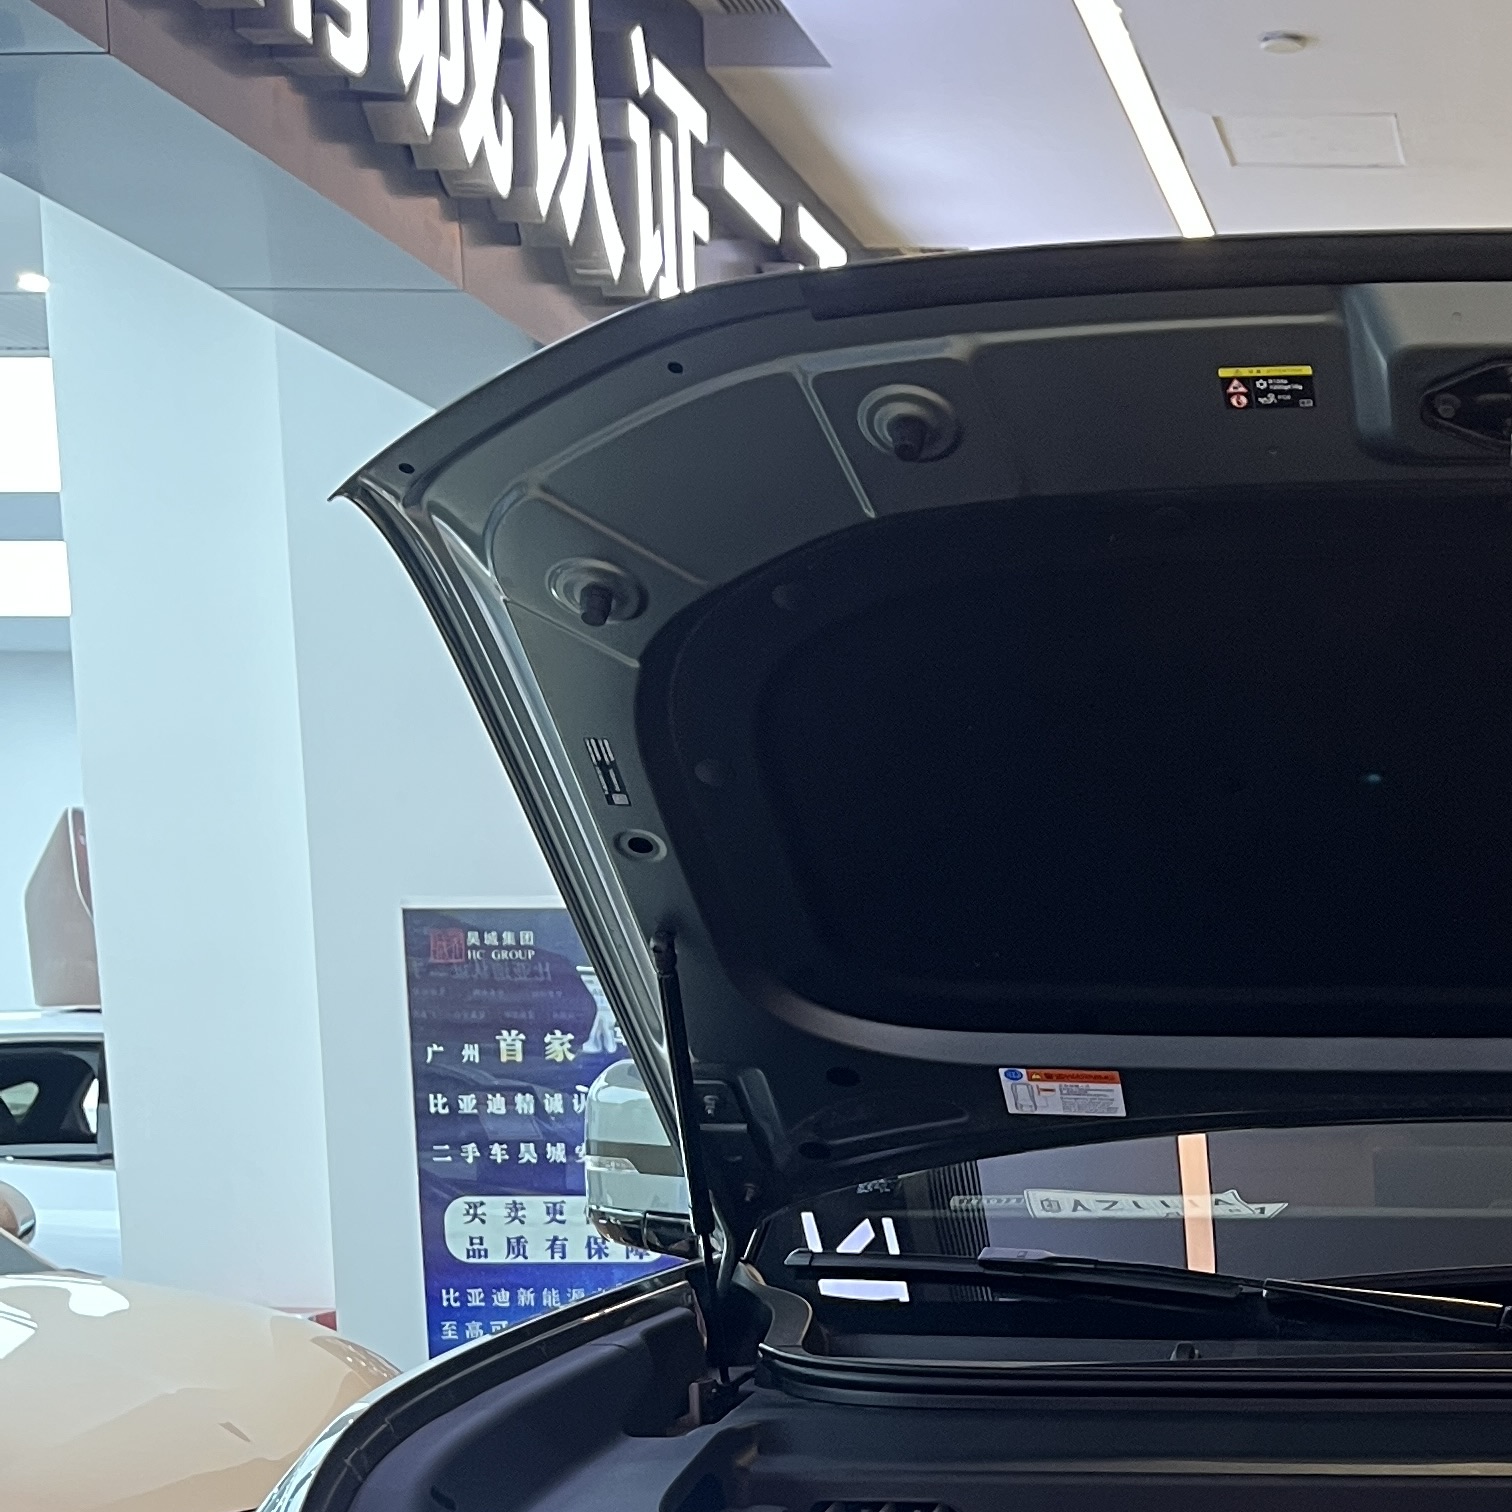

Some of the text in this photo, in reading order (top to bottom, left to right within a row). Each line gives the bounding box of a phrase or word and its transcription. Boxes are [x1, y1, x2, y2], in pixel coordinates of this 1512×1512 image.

[468, 949, 535, 960] HC GROUP
[463, 1200, 590, 1225] 买卖更
[441, 1283, 623, 1308] 比亚迪新能源
